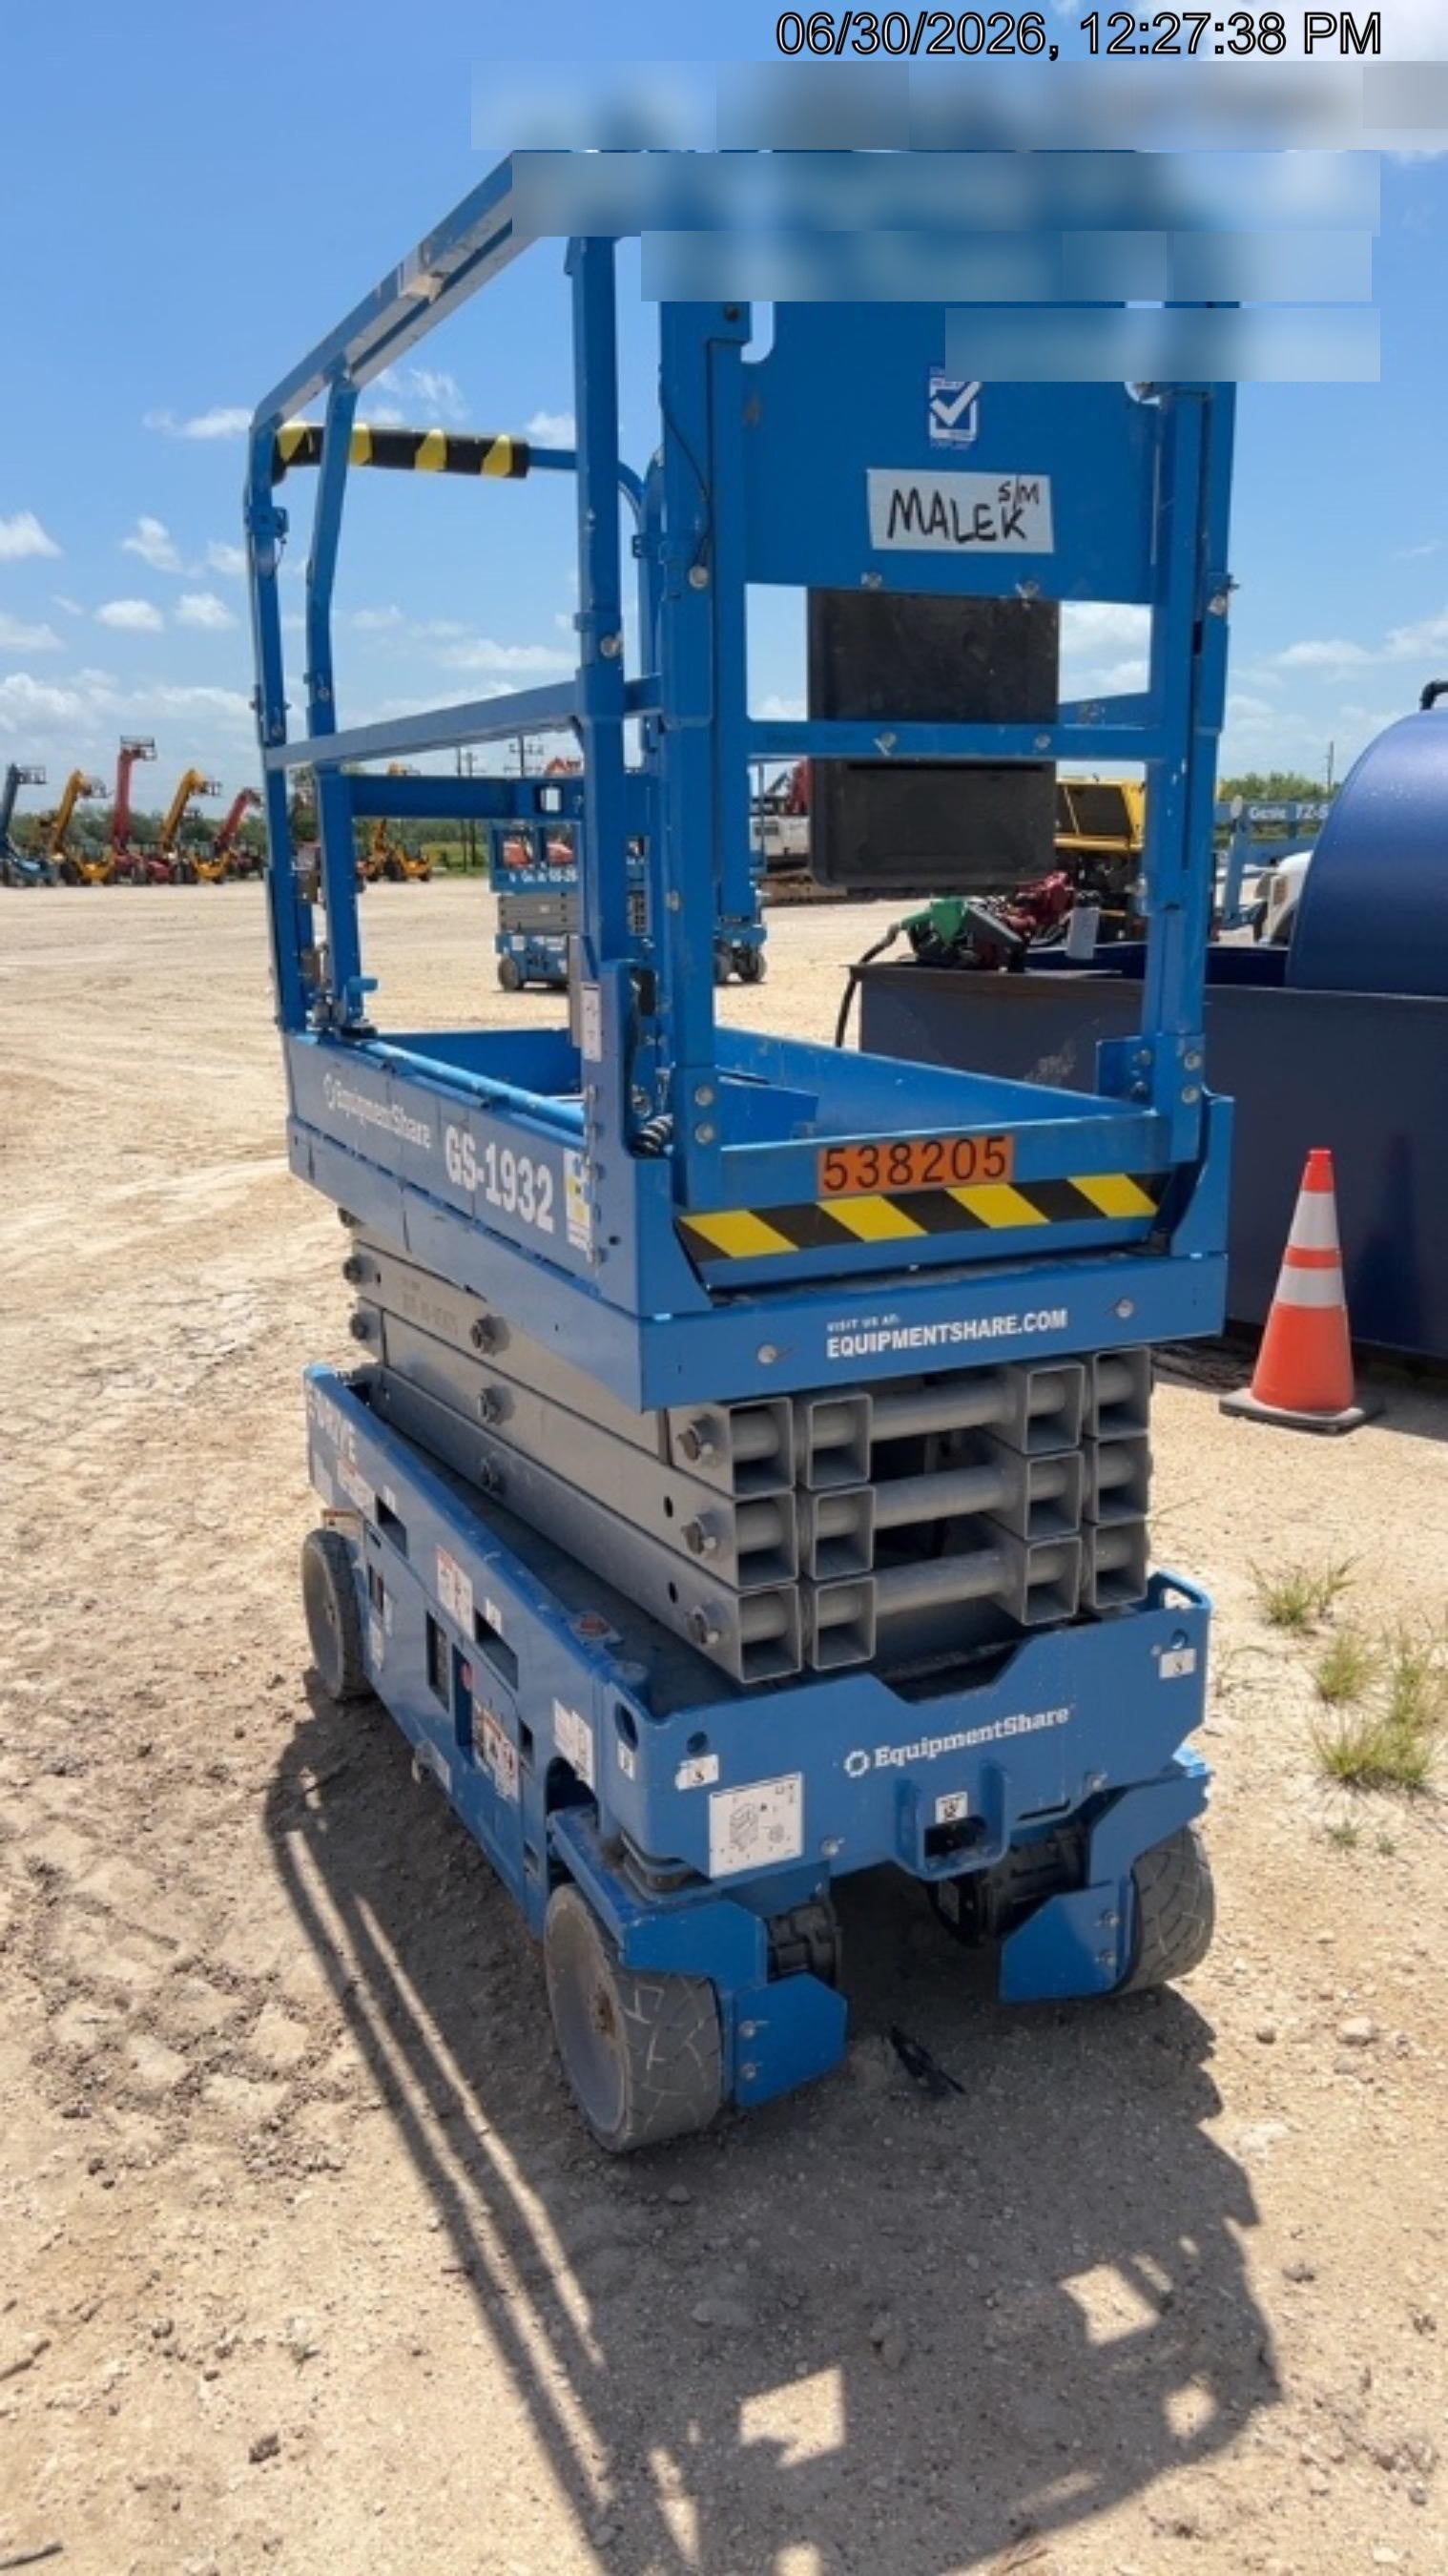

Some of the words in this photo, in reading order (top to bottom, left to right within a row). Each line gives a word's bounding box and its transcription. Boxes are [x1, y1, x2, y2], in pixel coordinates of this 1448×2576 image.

[887, 487, 1027, 544] MALEK
[445, 1124, 554, 1234] GS-1932
[823, 1136, 1006, 1191] 538205
[826, 1308, 1069, 1359] EQUIPMENTSHARE.COM
[874, 1707, 1070, 1768] EquipmentShare
